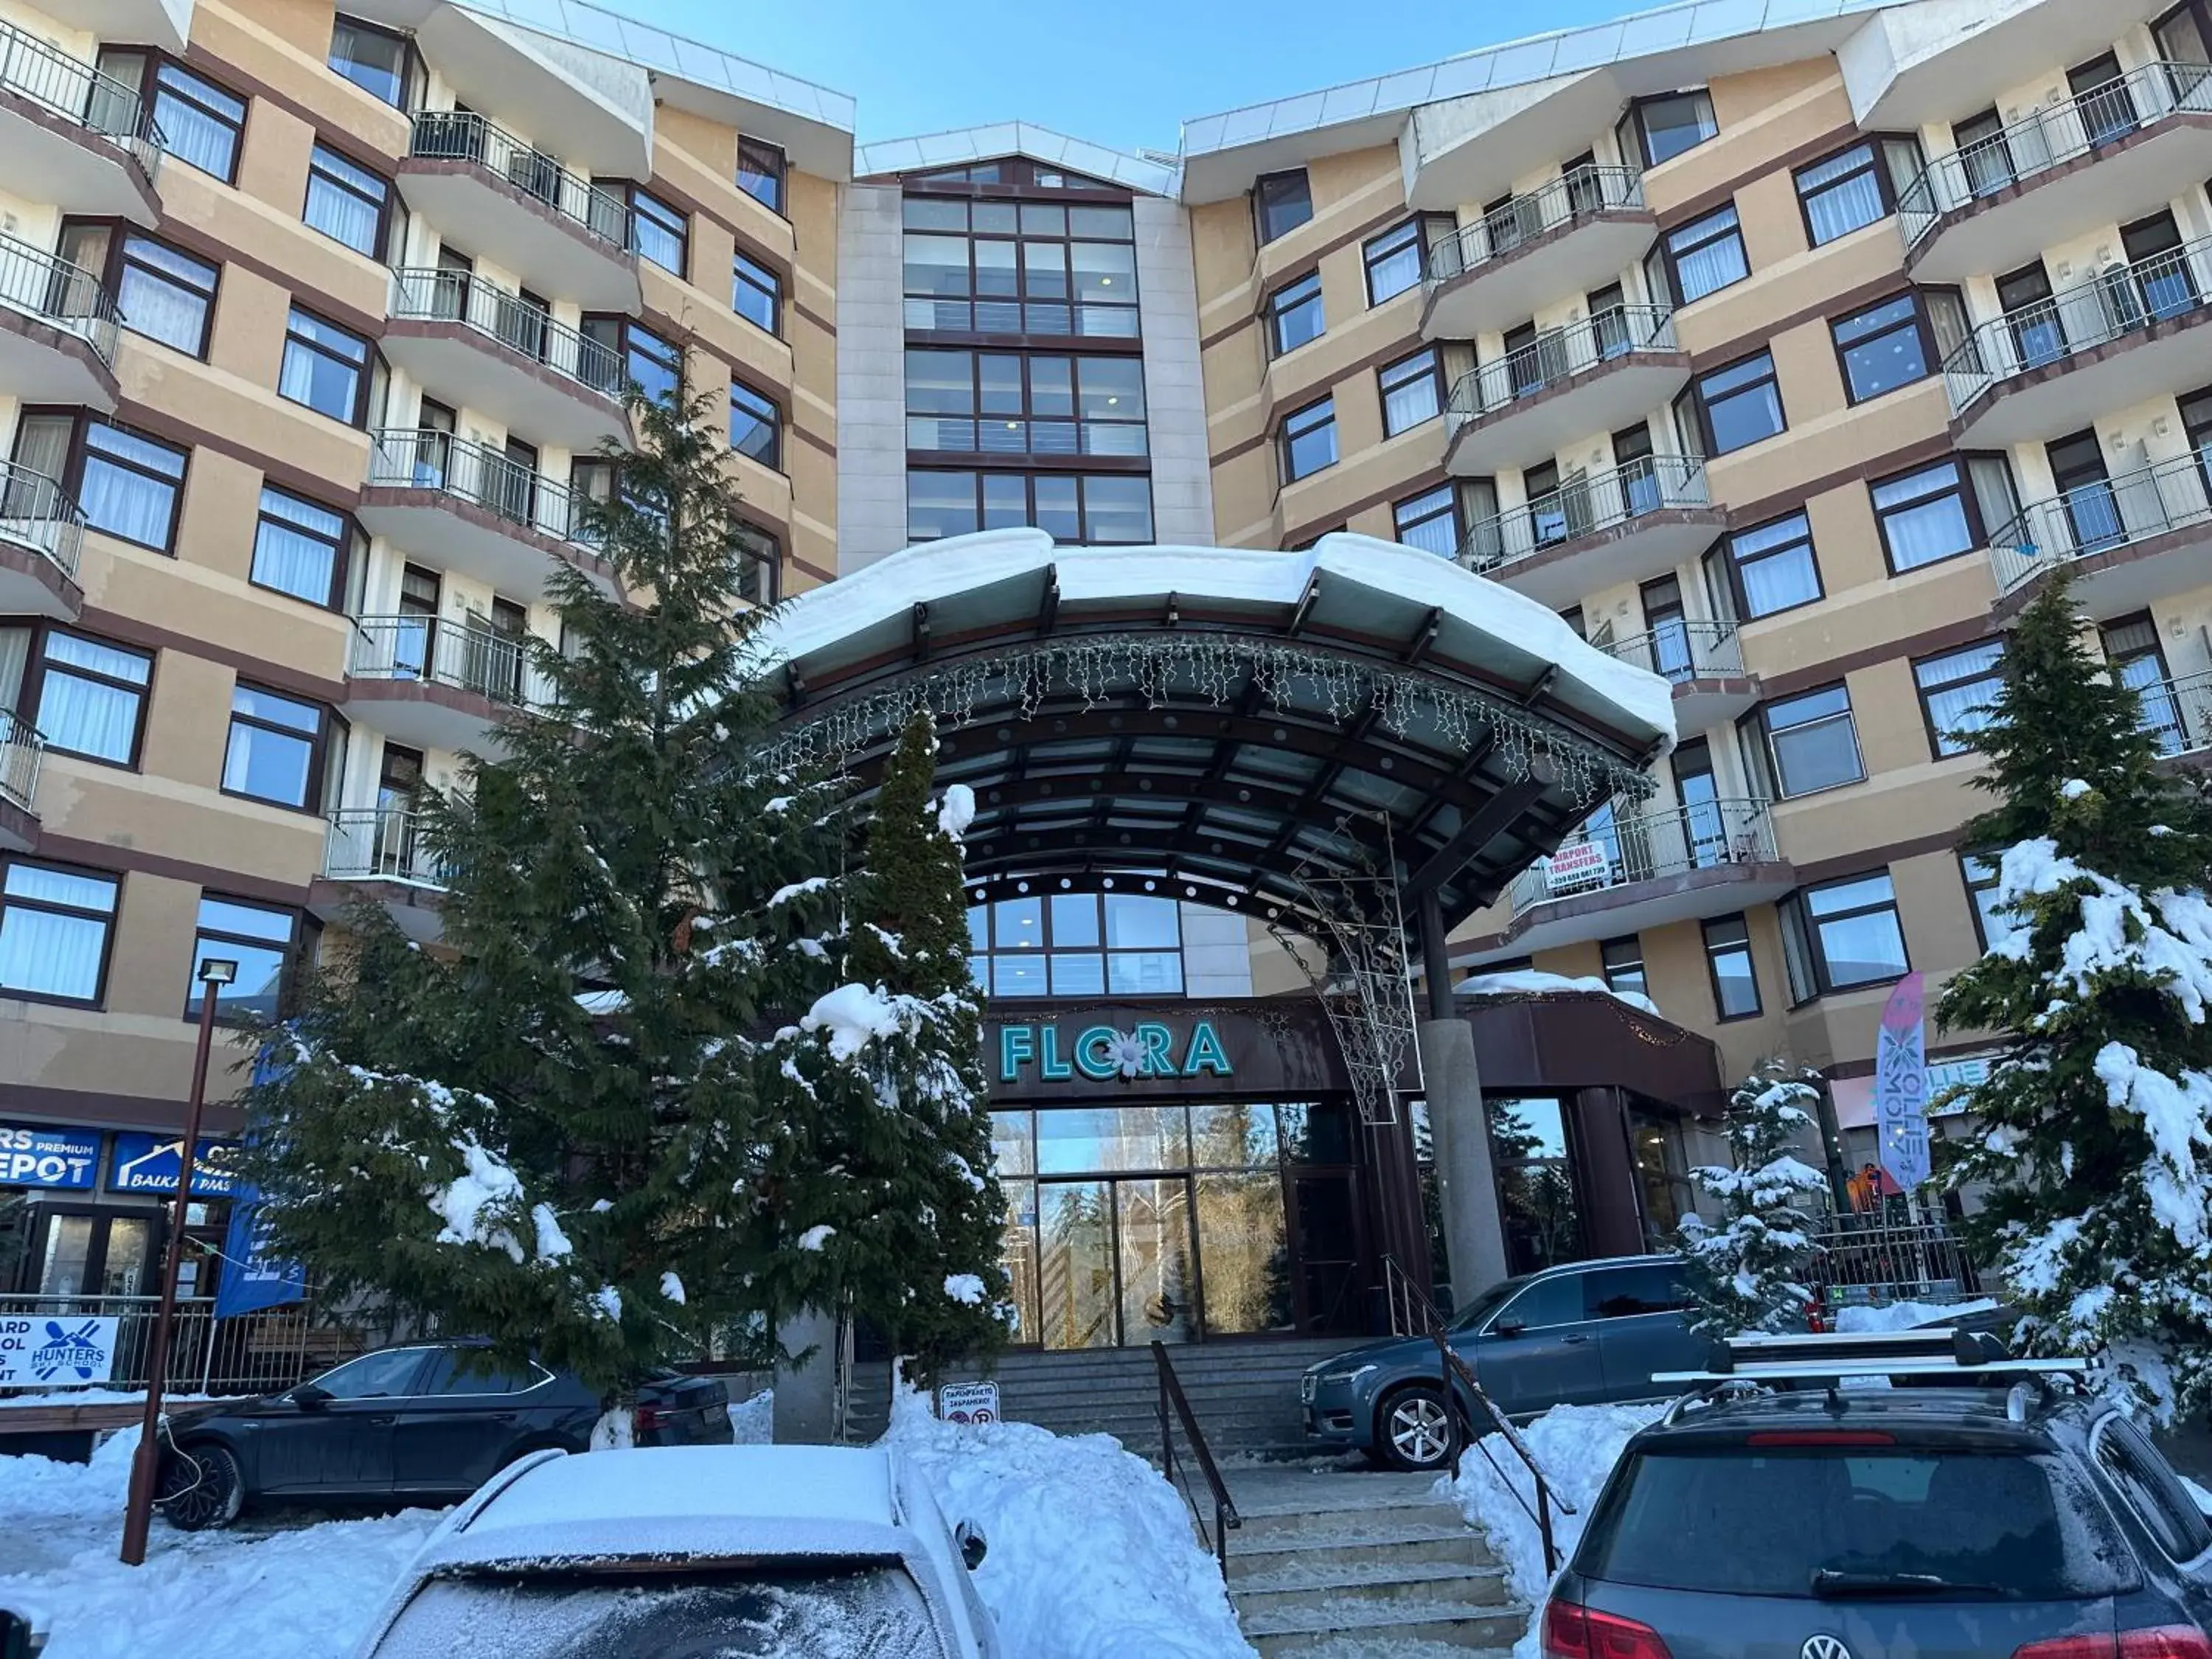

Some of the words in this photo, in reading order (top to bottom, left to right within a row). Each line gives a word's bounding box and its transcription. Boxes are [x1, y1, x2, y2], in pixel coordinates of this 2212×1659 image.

[1554, 844, 1593, 863] AIRPORT
[1548, 854, 1602, 874] TRANSFERS
[1001, 1020, 1234, 1082] FLORA
[1902, 1073, 1924, 1155] OLLIE
[37, 1142, 94, 1155] PREMIUM
[32, 1349, 105, 1363] HUNTERS
[58, 1360, 103, 1368] SCHOOL
